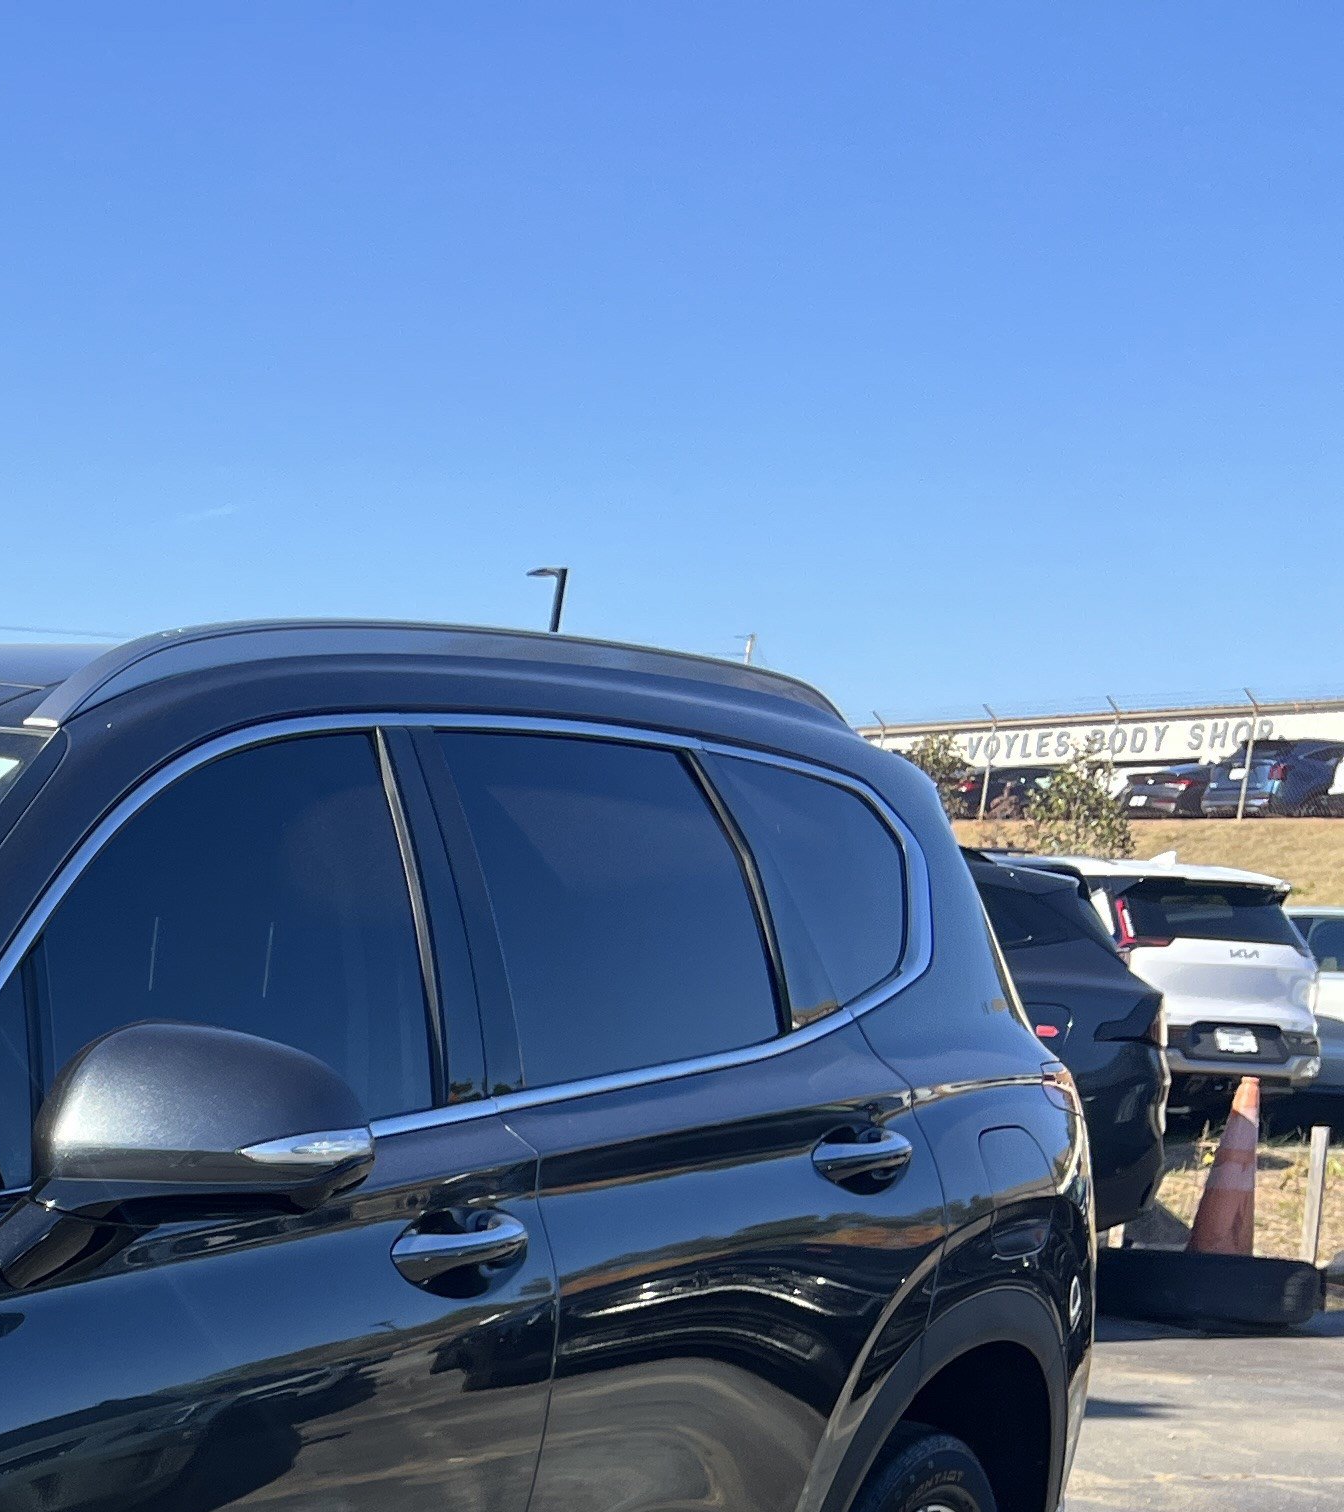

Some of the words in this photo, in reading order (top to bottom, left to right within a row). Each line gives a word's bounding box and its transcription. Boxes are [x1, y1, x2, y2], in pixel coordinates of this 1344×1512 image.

[967, 731, 1070, 760] VOYLES
[1086, 725, 1169, 754] BODY
[1187, 719, 1274, 750] SHOP
[1229, 948, 1260, 959] KIA
